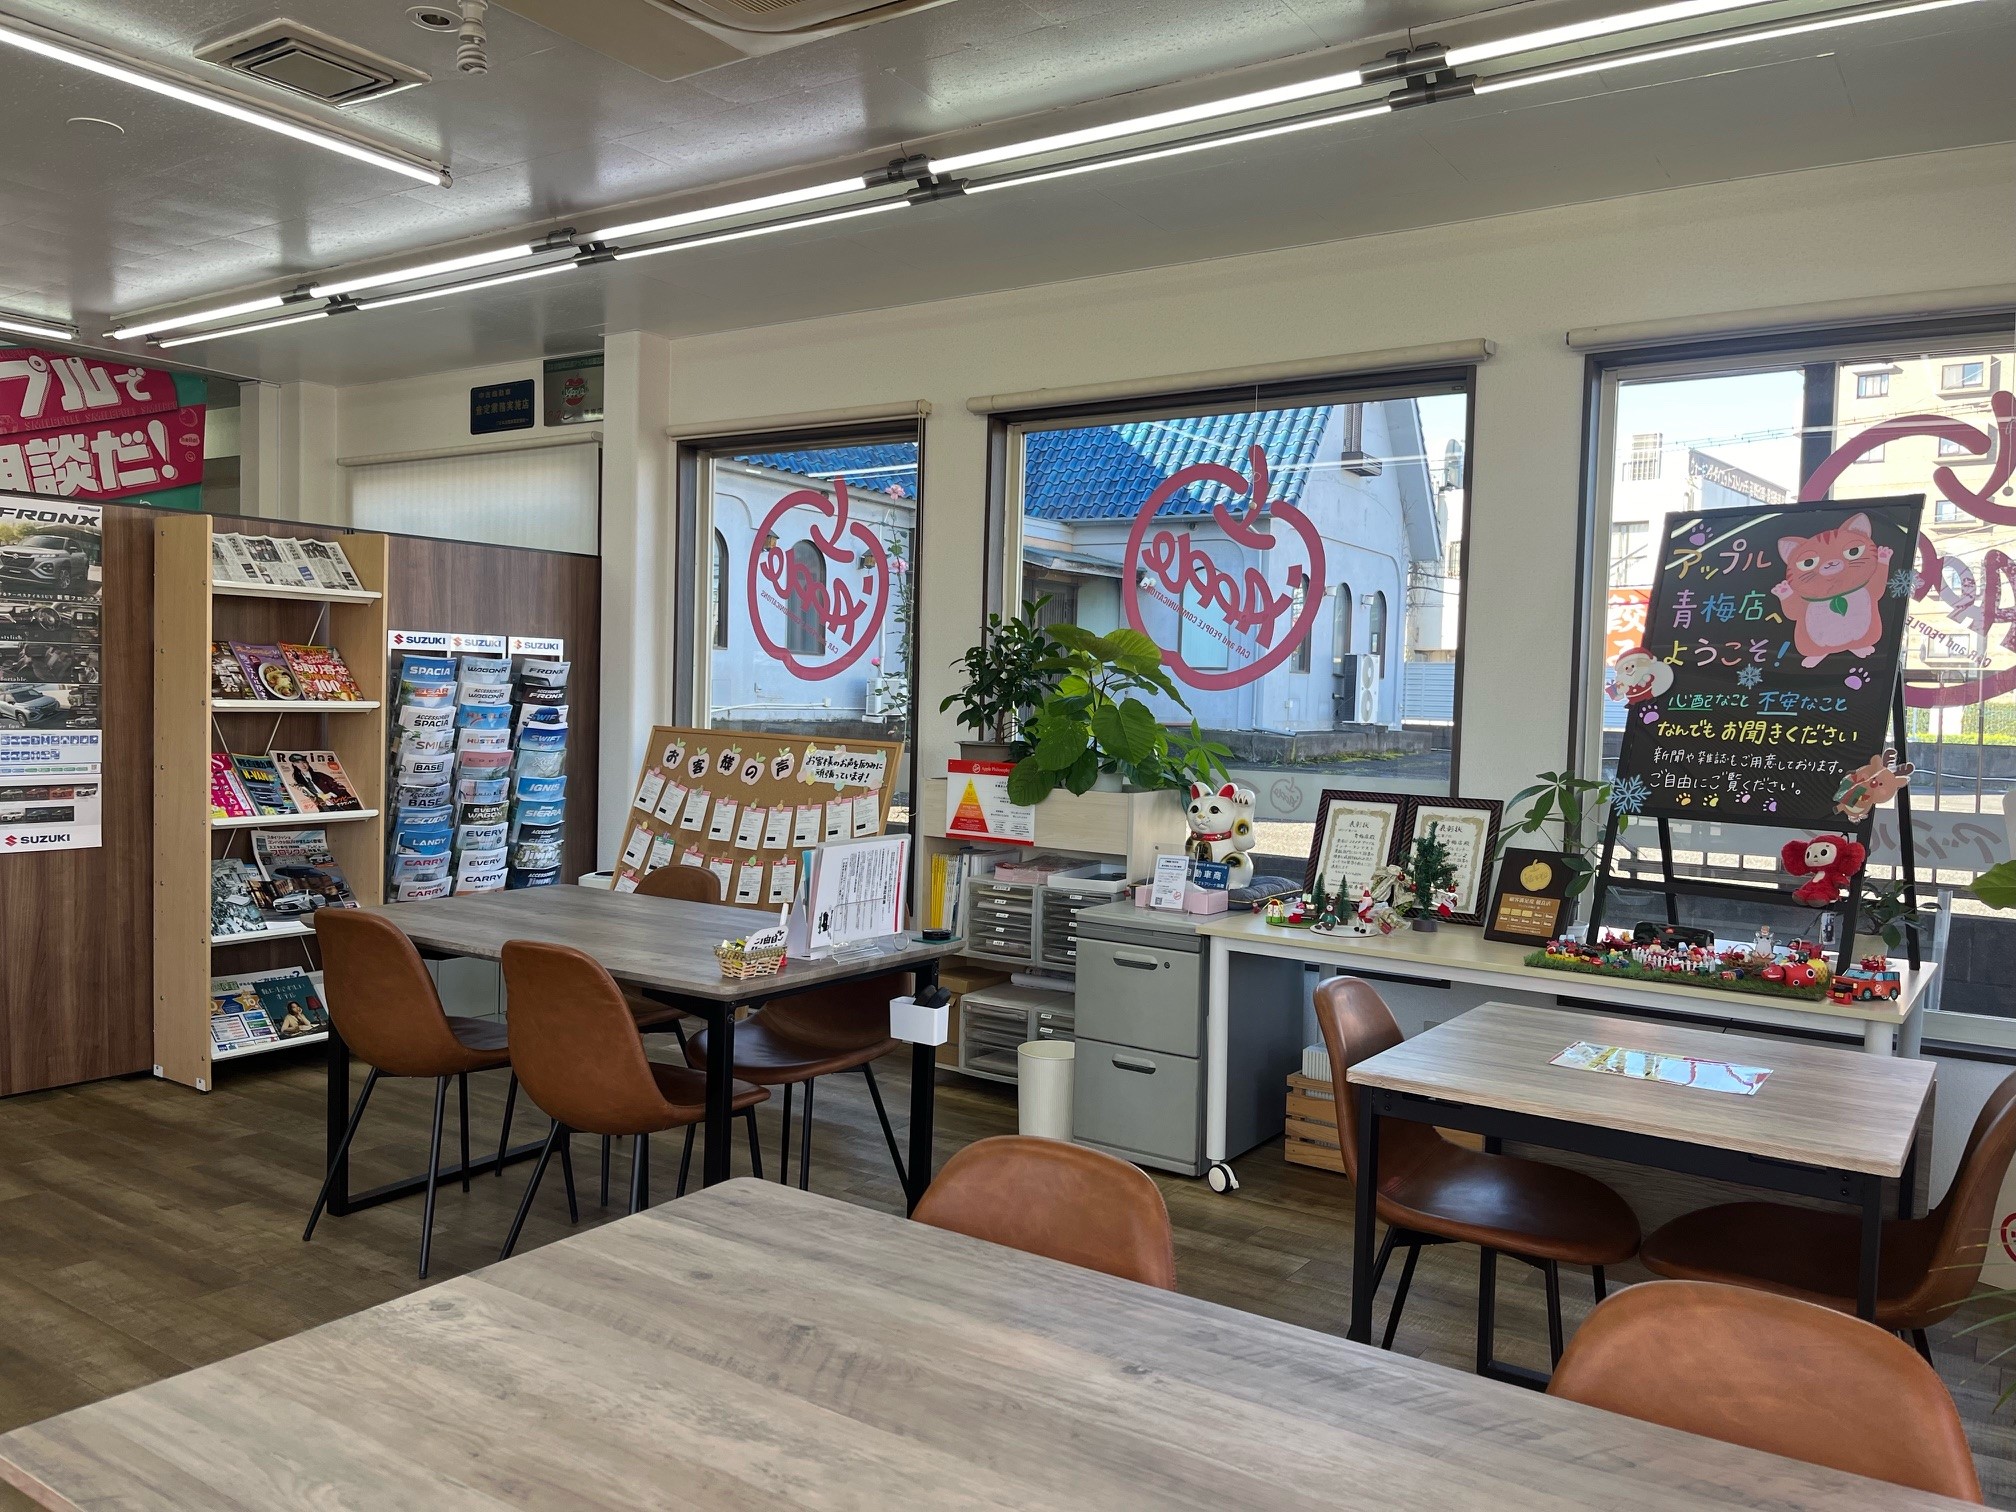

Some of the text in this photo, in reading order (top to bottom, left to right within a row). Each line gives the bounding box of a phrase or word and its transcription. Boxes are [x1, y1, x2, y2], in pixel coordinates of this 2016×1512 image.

[0, 507, 100, 527] FRONX
[1673, 538, 1772, 581] アップル
[1672, 589, 1783, 629] 青梅店へ
[406, 636, 446, 645] SUZUKI
[464, 639, 501, 648] SUZUKI
[524, 642, 559, 650] SUZUKI
[1663, 637, 1792, 668] ようこそ!
[410, 666, 451, 676] SPACIA
[528, 667, 565, 675] FRONX
[314, 679, 341, 693] 100
[529, 692, 564, 700] FRONX
[1667, 691, 1848, 713] 心配なこと 不安なこと
[466, 712, 508, 720] HUSTLER
[527, 713, 564, 721] SWIFT
[414, 720, 449, 728] SPACIA
[1657, 718, 1859, 745] なんでも お聞きください
[530, 734, 562, 742] SWIFT
[415, 740, 450, 750] SMILE
[276, 753, 335, 763] Rina
[416, 763, 443, 771] BASE
[665, 749, 790, 780] お客様の声
[814, 769, 870, 784] 頑張っています!
[1650, 768, 1801, 796] ご自由にご覧ください。
[529, 783, 560, 792] IGNIS
[408, 798, 442, 807] BASE
[467, 811, 503, 819] WAGON
[525, 809, 562, 817] SIERRA
[404, 814, 448, 825] ESCUDO
[465, 828, 504, 837] EVERY
[20, 834, 70, 845] SUZUKI
[412, 837, 447, 846] LANDY
[522, 850, 558, 863] Jimny
[404, 857, 445, 867] CARRY
[468, 857, 502, 867] EVERY
[465, 872, 504, 883] CARRY
[406, 886, 446, 898] CARRY
